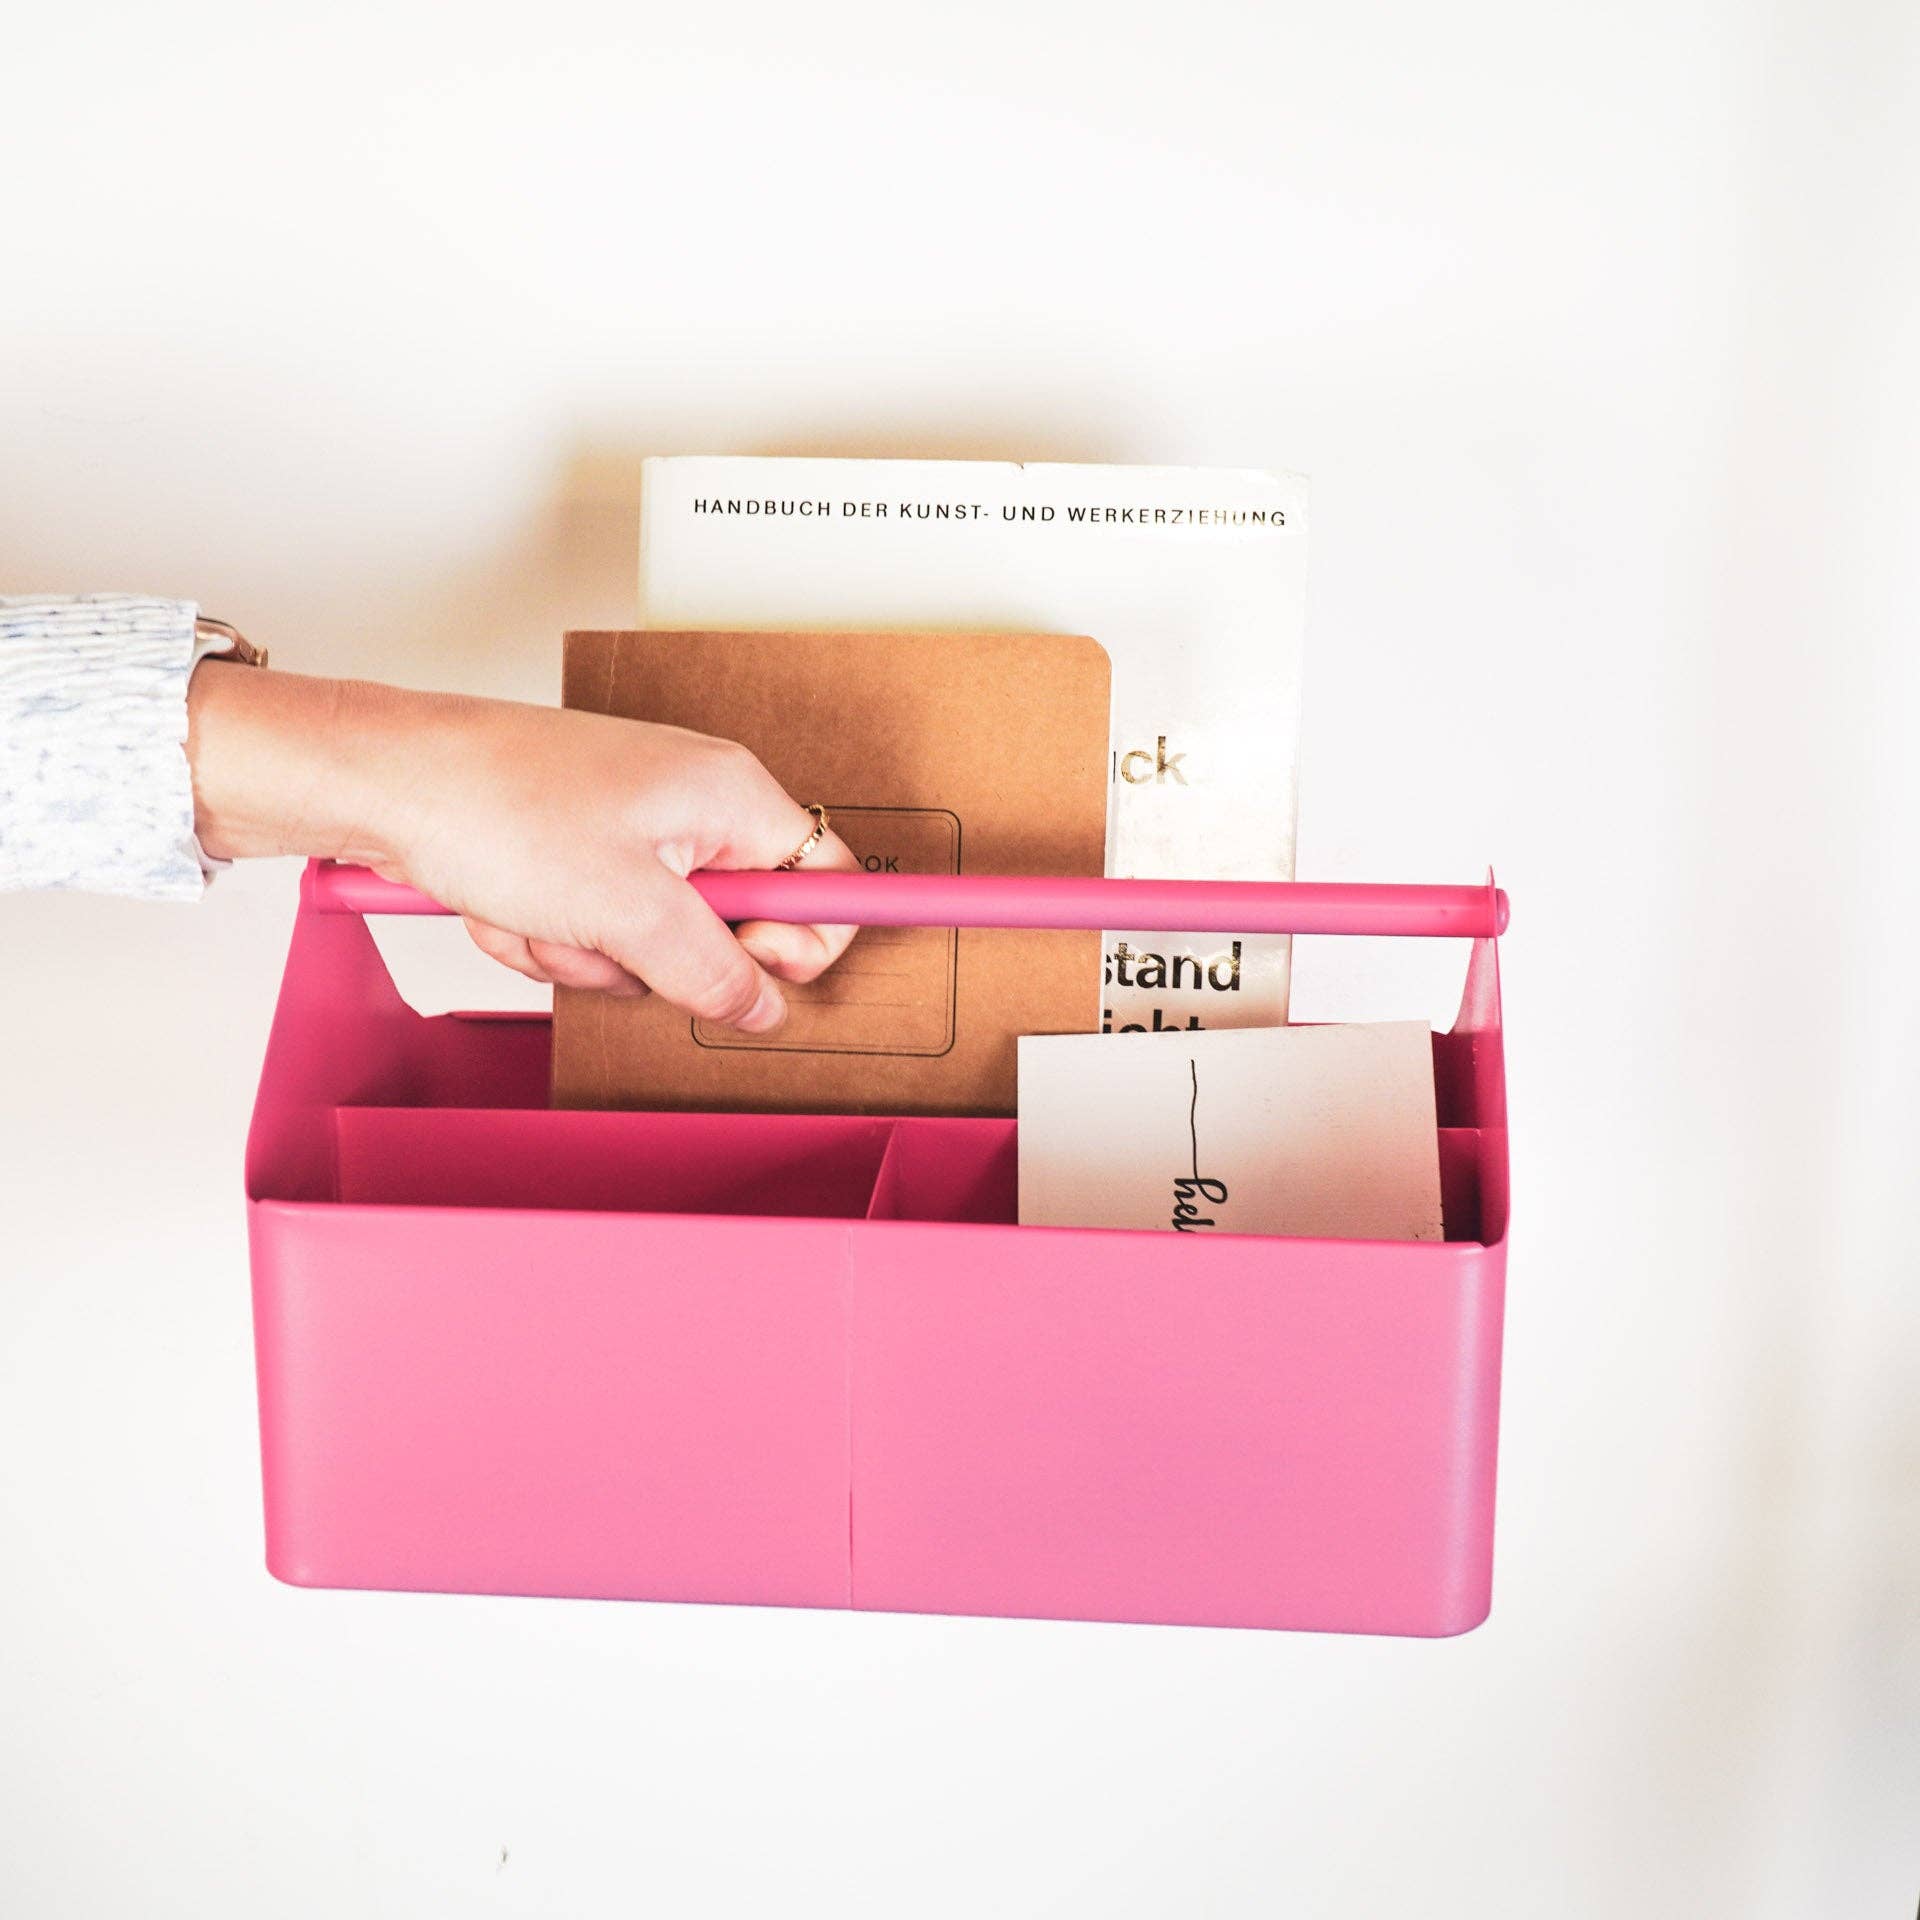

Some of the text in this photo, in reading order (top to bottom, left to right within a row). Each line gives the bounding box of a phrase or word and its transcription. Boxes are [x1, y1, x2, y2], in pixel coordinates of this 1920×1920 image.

[694, 498, 1286, 527] HANDBUCH DER KUNST- UND WERKERZIEHUNG
[1112, 735, 1188, 786] ck
